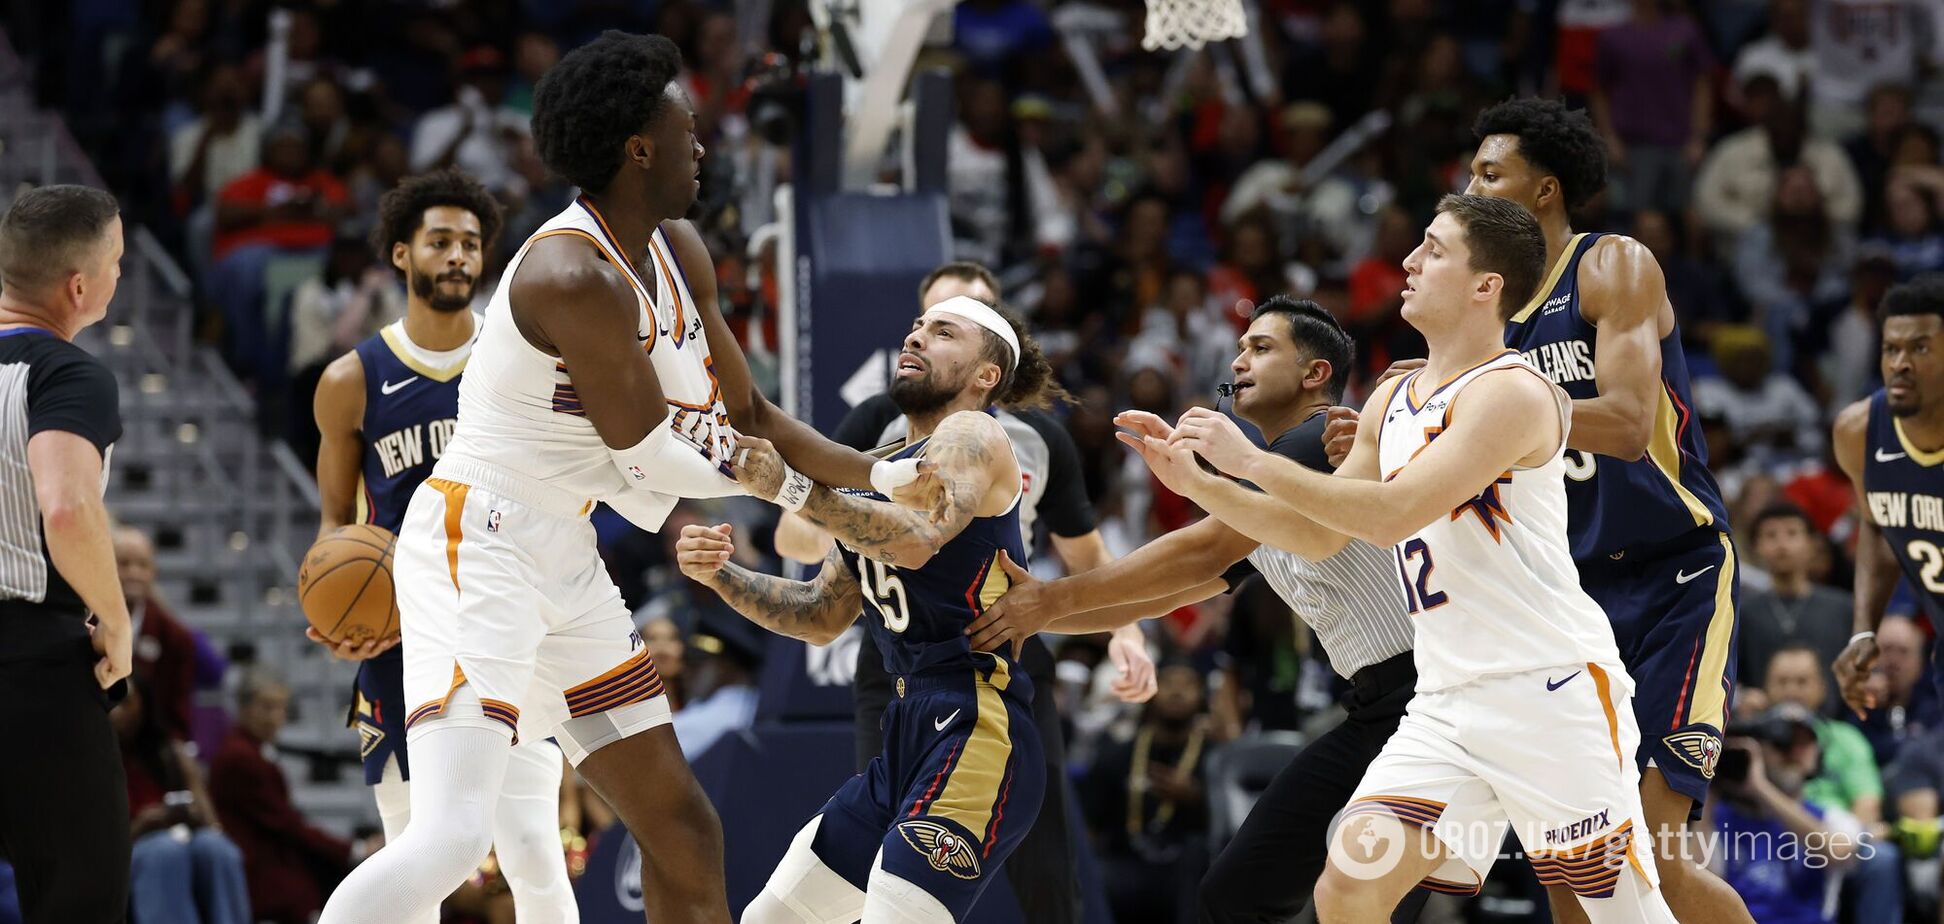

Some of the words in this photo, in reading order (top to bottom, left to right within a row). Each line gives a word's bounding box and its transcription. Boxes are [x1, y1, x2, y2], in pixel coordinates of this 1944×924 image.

[1521, 340, 1596, 384] LEANS
[374, 424, 423, 478] NEW
[1867, 492, 1907, 527] NEW
[1395, 537, 1450, 614] 12
[1907, 540, 1944, 593] 2
[857, 555, 910, 633] 15
[1544, 808, 1610, 844] PHOENIX
